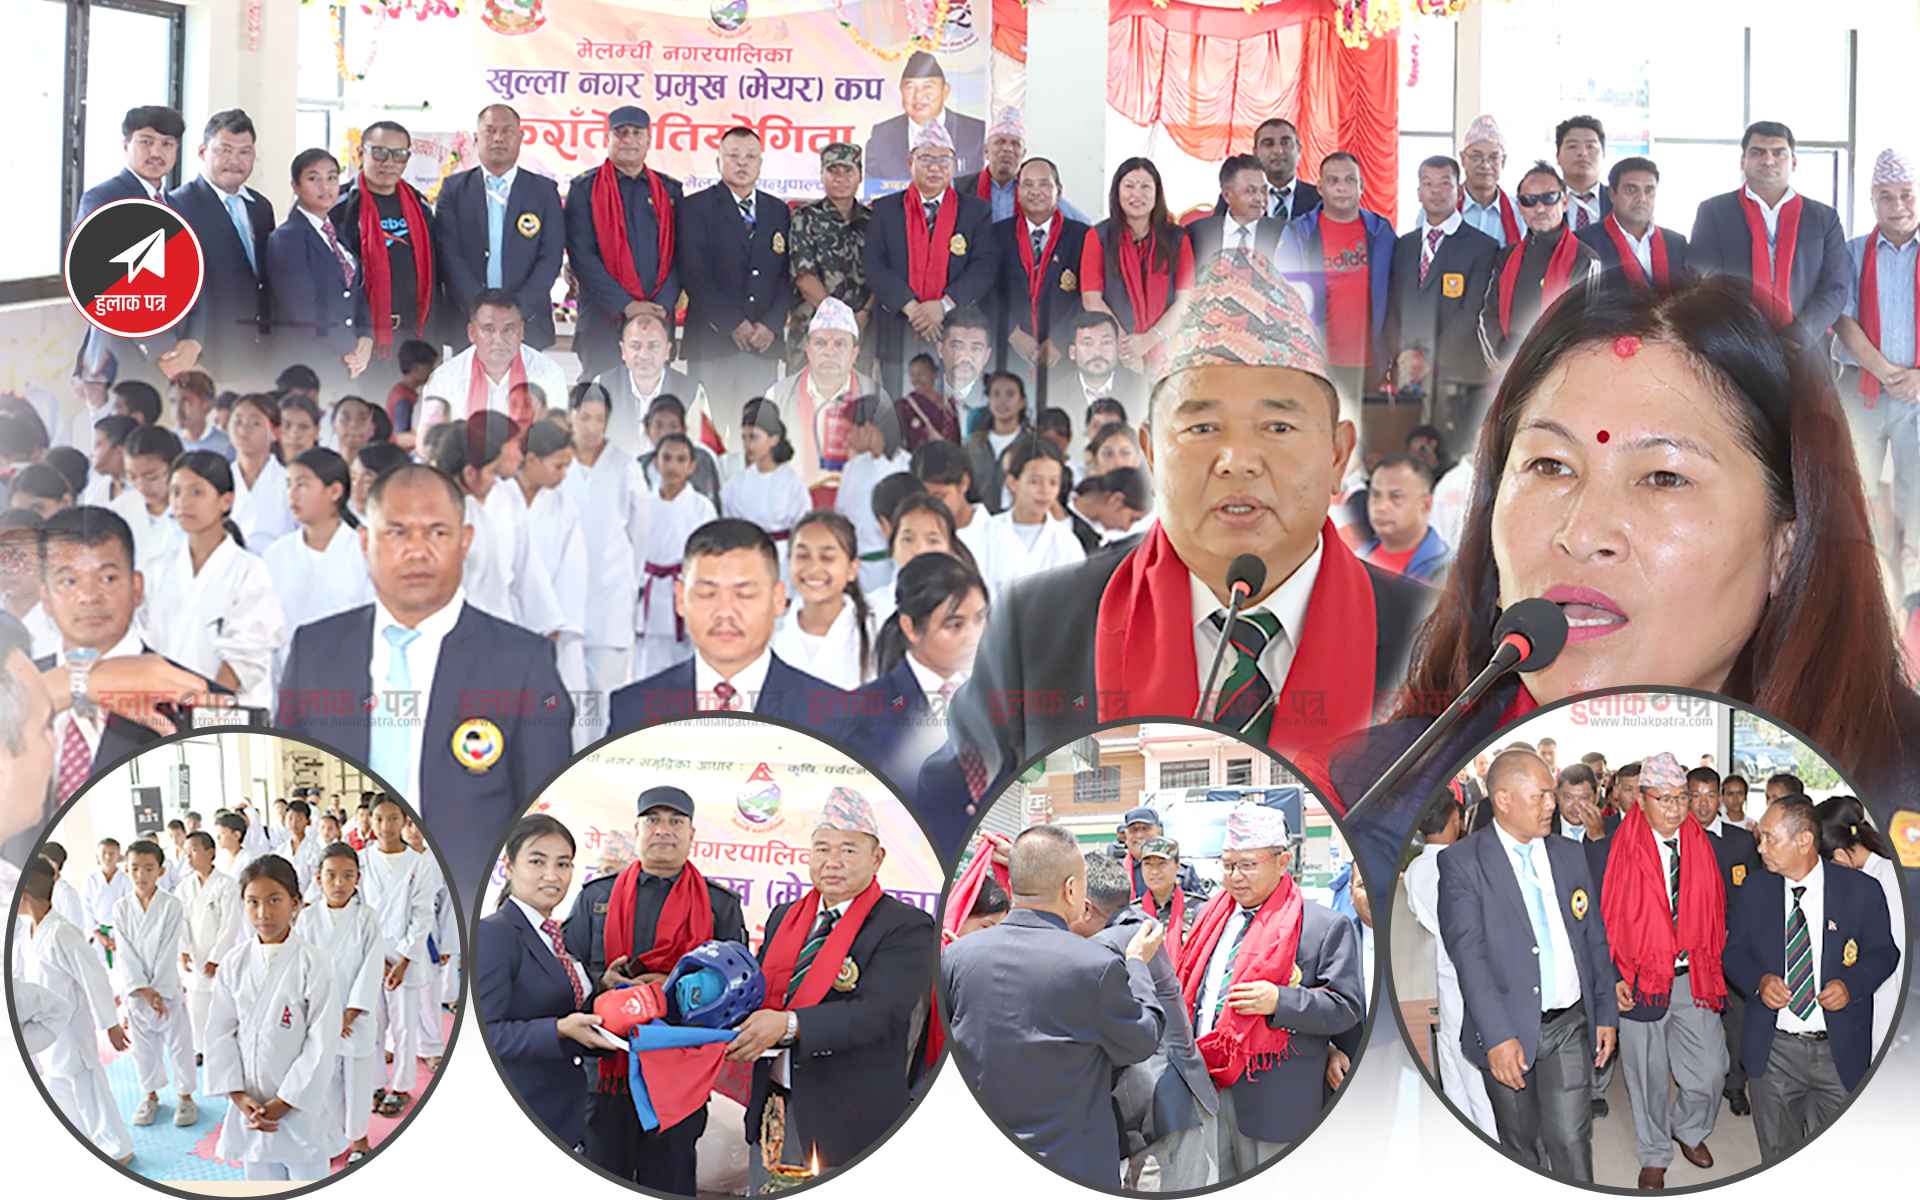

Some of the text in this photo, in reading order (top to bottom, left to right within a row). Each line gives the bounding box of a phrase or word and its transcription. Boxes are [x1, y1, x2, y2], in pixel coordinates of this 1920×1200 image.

[576, 37, 792, 63] मेलम्ची नगरपालिका
[486, 67, 886, 105] खुल्ला नगर प्रमुख (मेयर) कप
